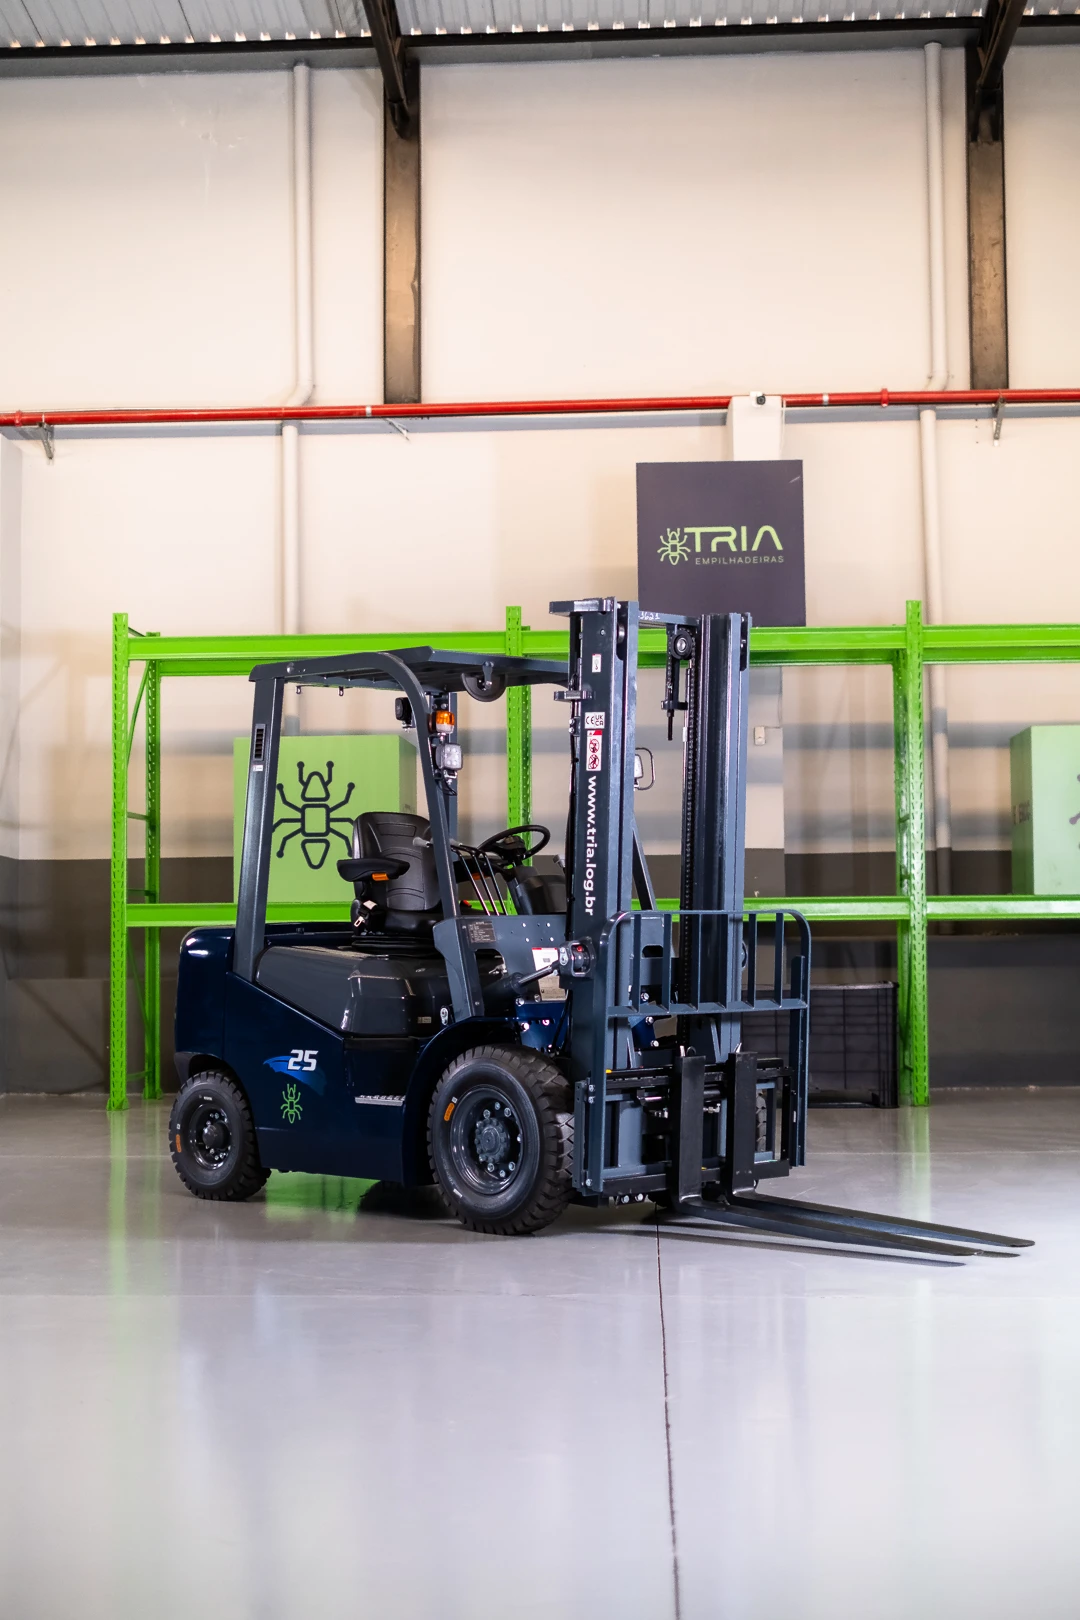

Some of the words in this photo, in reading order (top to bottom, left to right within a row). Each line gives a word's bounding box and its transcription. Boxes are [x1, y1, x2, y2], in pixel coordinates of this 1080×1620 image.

[684, 525, 783, 552] TRIA
[695, 556, 784, 565] EMPILHADEIRAS
[583, 776, 598, 916] www.tria.log.br
[287, 1049, 319, 1071] 25
